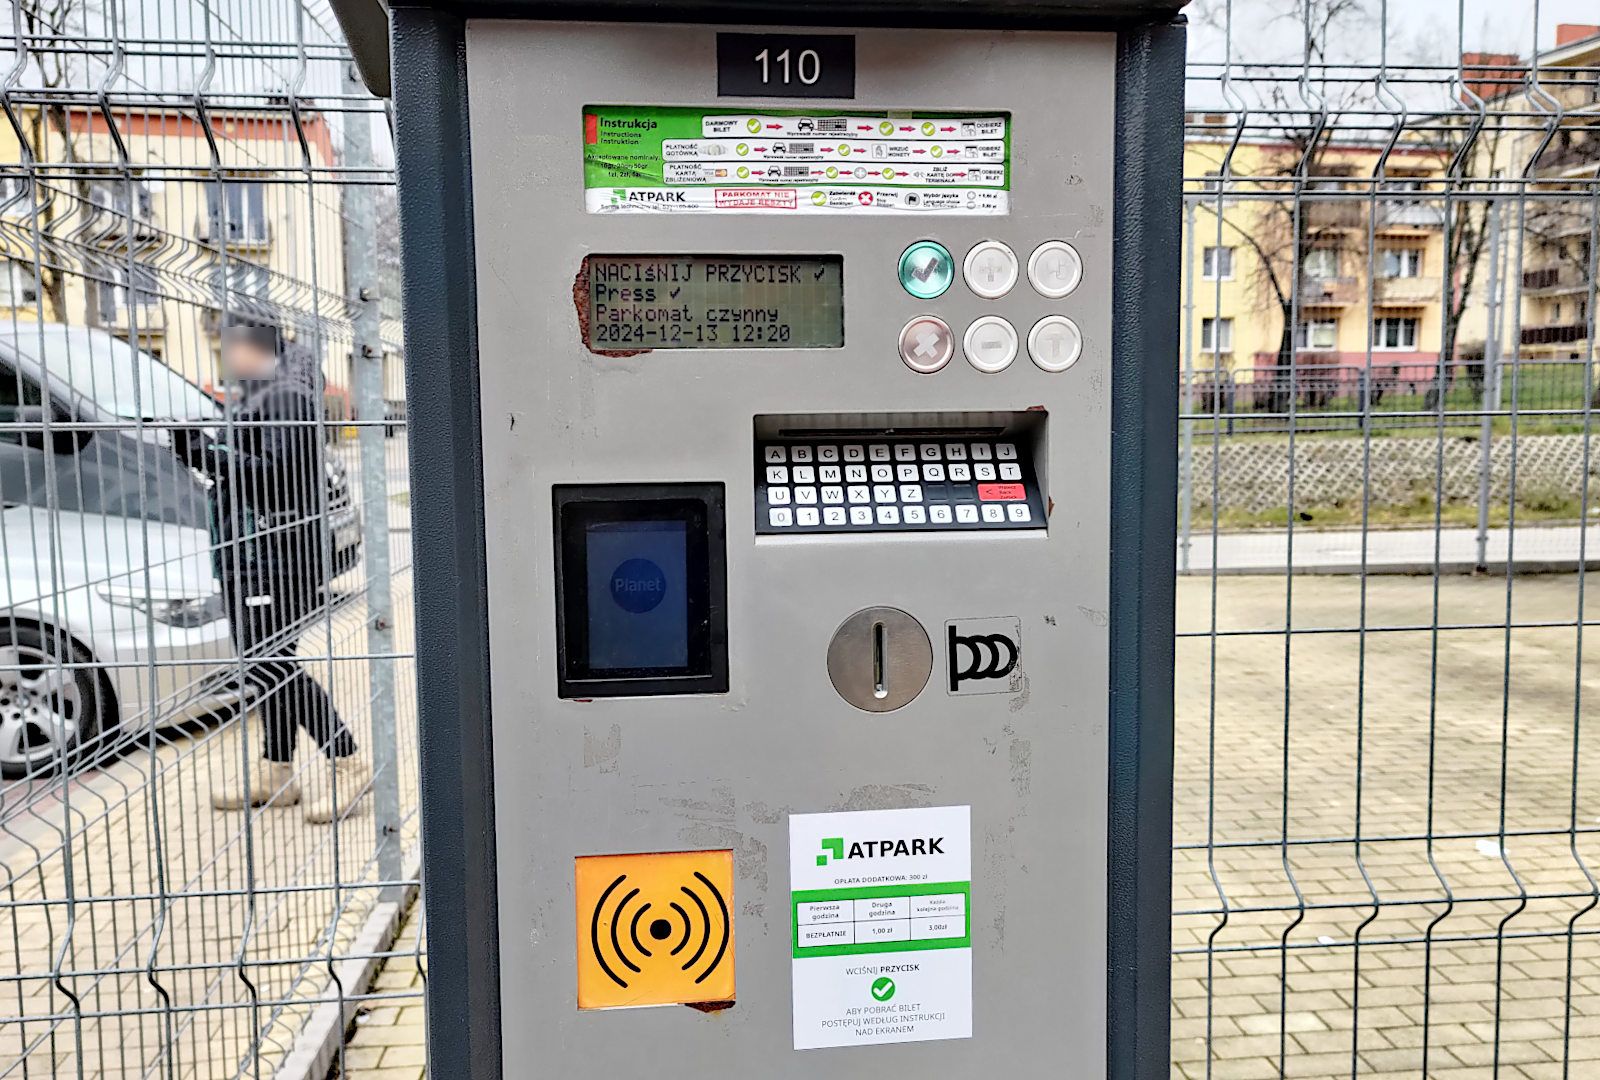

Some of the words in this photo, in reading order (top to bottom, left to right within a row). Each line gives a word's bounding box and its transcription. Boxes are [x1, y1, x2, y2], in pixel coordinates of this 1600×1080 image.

[755, 49, 820, 84] 110
[600, 117, 657, 131] Instrukcja
[600, 130, 641, 138] Instructions
[629, 191, 686, 202] ATPARK
[706, 264, 801, 283] PRZYCISK
[596, 284, 656, 301] Press
[596, 304, 693, 322] Parkomat
[706, 308, 779, 322] czynny
[596, 325, 718, 342] 2024-12-13
[733, 324, 791, 342] 12:20
[770, 450, 781, 459] A
[797, 449, 807, 459] B
[823, 449, 833, 458] C
[849, 449, 859, 458] D
[876, 448, 885, 457] E
[901, 448, 909, 457] F
[926, 448, 936, 457] G
[951, 448, 961, 456] H
[980, 447, 984, 456] I
[1004, 447, 1010, 456] J
[773, 470, 782, 479] K
[799, 470, 808, 479] L
[825, 470, 836, 478] M
[852, 469, 861, 478] N
[877, 469, 888, 478] O
[903, 469, 912, 477] P
[928, 468, 939, 477] Q
[955, 468, 965, 477] R
[981, 467, 990, 476] S
[1005, 467, 1014, 475] T
[775, 491, 784, 500] U
[801, 491, 810, 500] V
[825, 490, 839, 499] W
[854, 490, 864, 499] X
[880, 489, 890, 498] Y
[907, 489, 916, 498] Z
[777, 513, 785, 522] 0
[807, 512, 812, 521] 1
[832, 512, 839, 521] 2
[858, 511, 866, 520] 3
[884, 511, 892, 519] 4
[911, 511, 919, 519] 5
[937, 510, 945, 519] 6
[963, 510, 970, 518] 7
[990, 509, 997, 518] 8
[1015, 509, 1023, 518] 9
[614, 578, 662, 592] Planet
[848, 837, 944, 859] ATPARK
[834, 877, 861, 885] OPŁATA
[862, 874, 908, 883] DODATKOWA:
[809, 904, 840, 912] Pierwsza
[872, 902, 893, 910] Druga
[812, 913, 839, 921] godzina
[868, 909, 896, 918] godzina
[805, 930, 847, 939] BEZPŁATNIE
[872, 927, 886, 935] 1,00
[846, 965, 878, 976] WCIŚNIJ
[880, 963, 920, 973] PRZYCISK
[846, 1007, 862, 1016] ABY
[864, 1004, 897, 1014] POBRAĆ
[899, 1004, 921, 1012] BILET
[821, 1018, 861, 1028] POSTĘPUJ
[862, 1015, 898, 1025] WEDŁUG
[900, 1012, 945, 1022] INSTRUKCJI
[855, 1028, 874, 1036] NAD
[875, 1025, 915, 1035] EKRANEM
